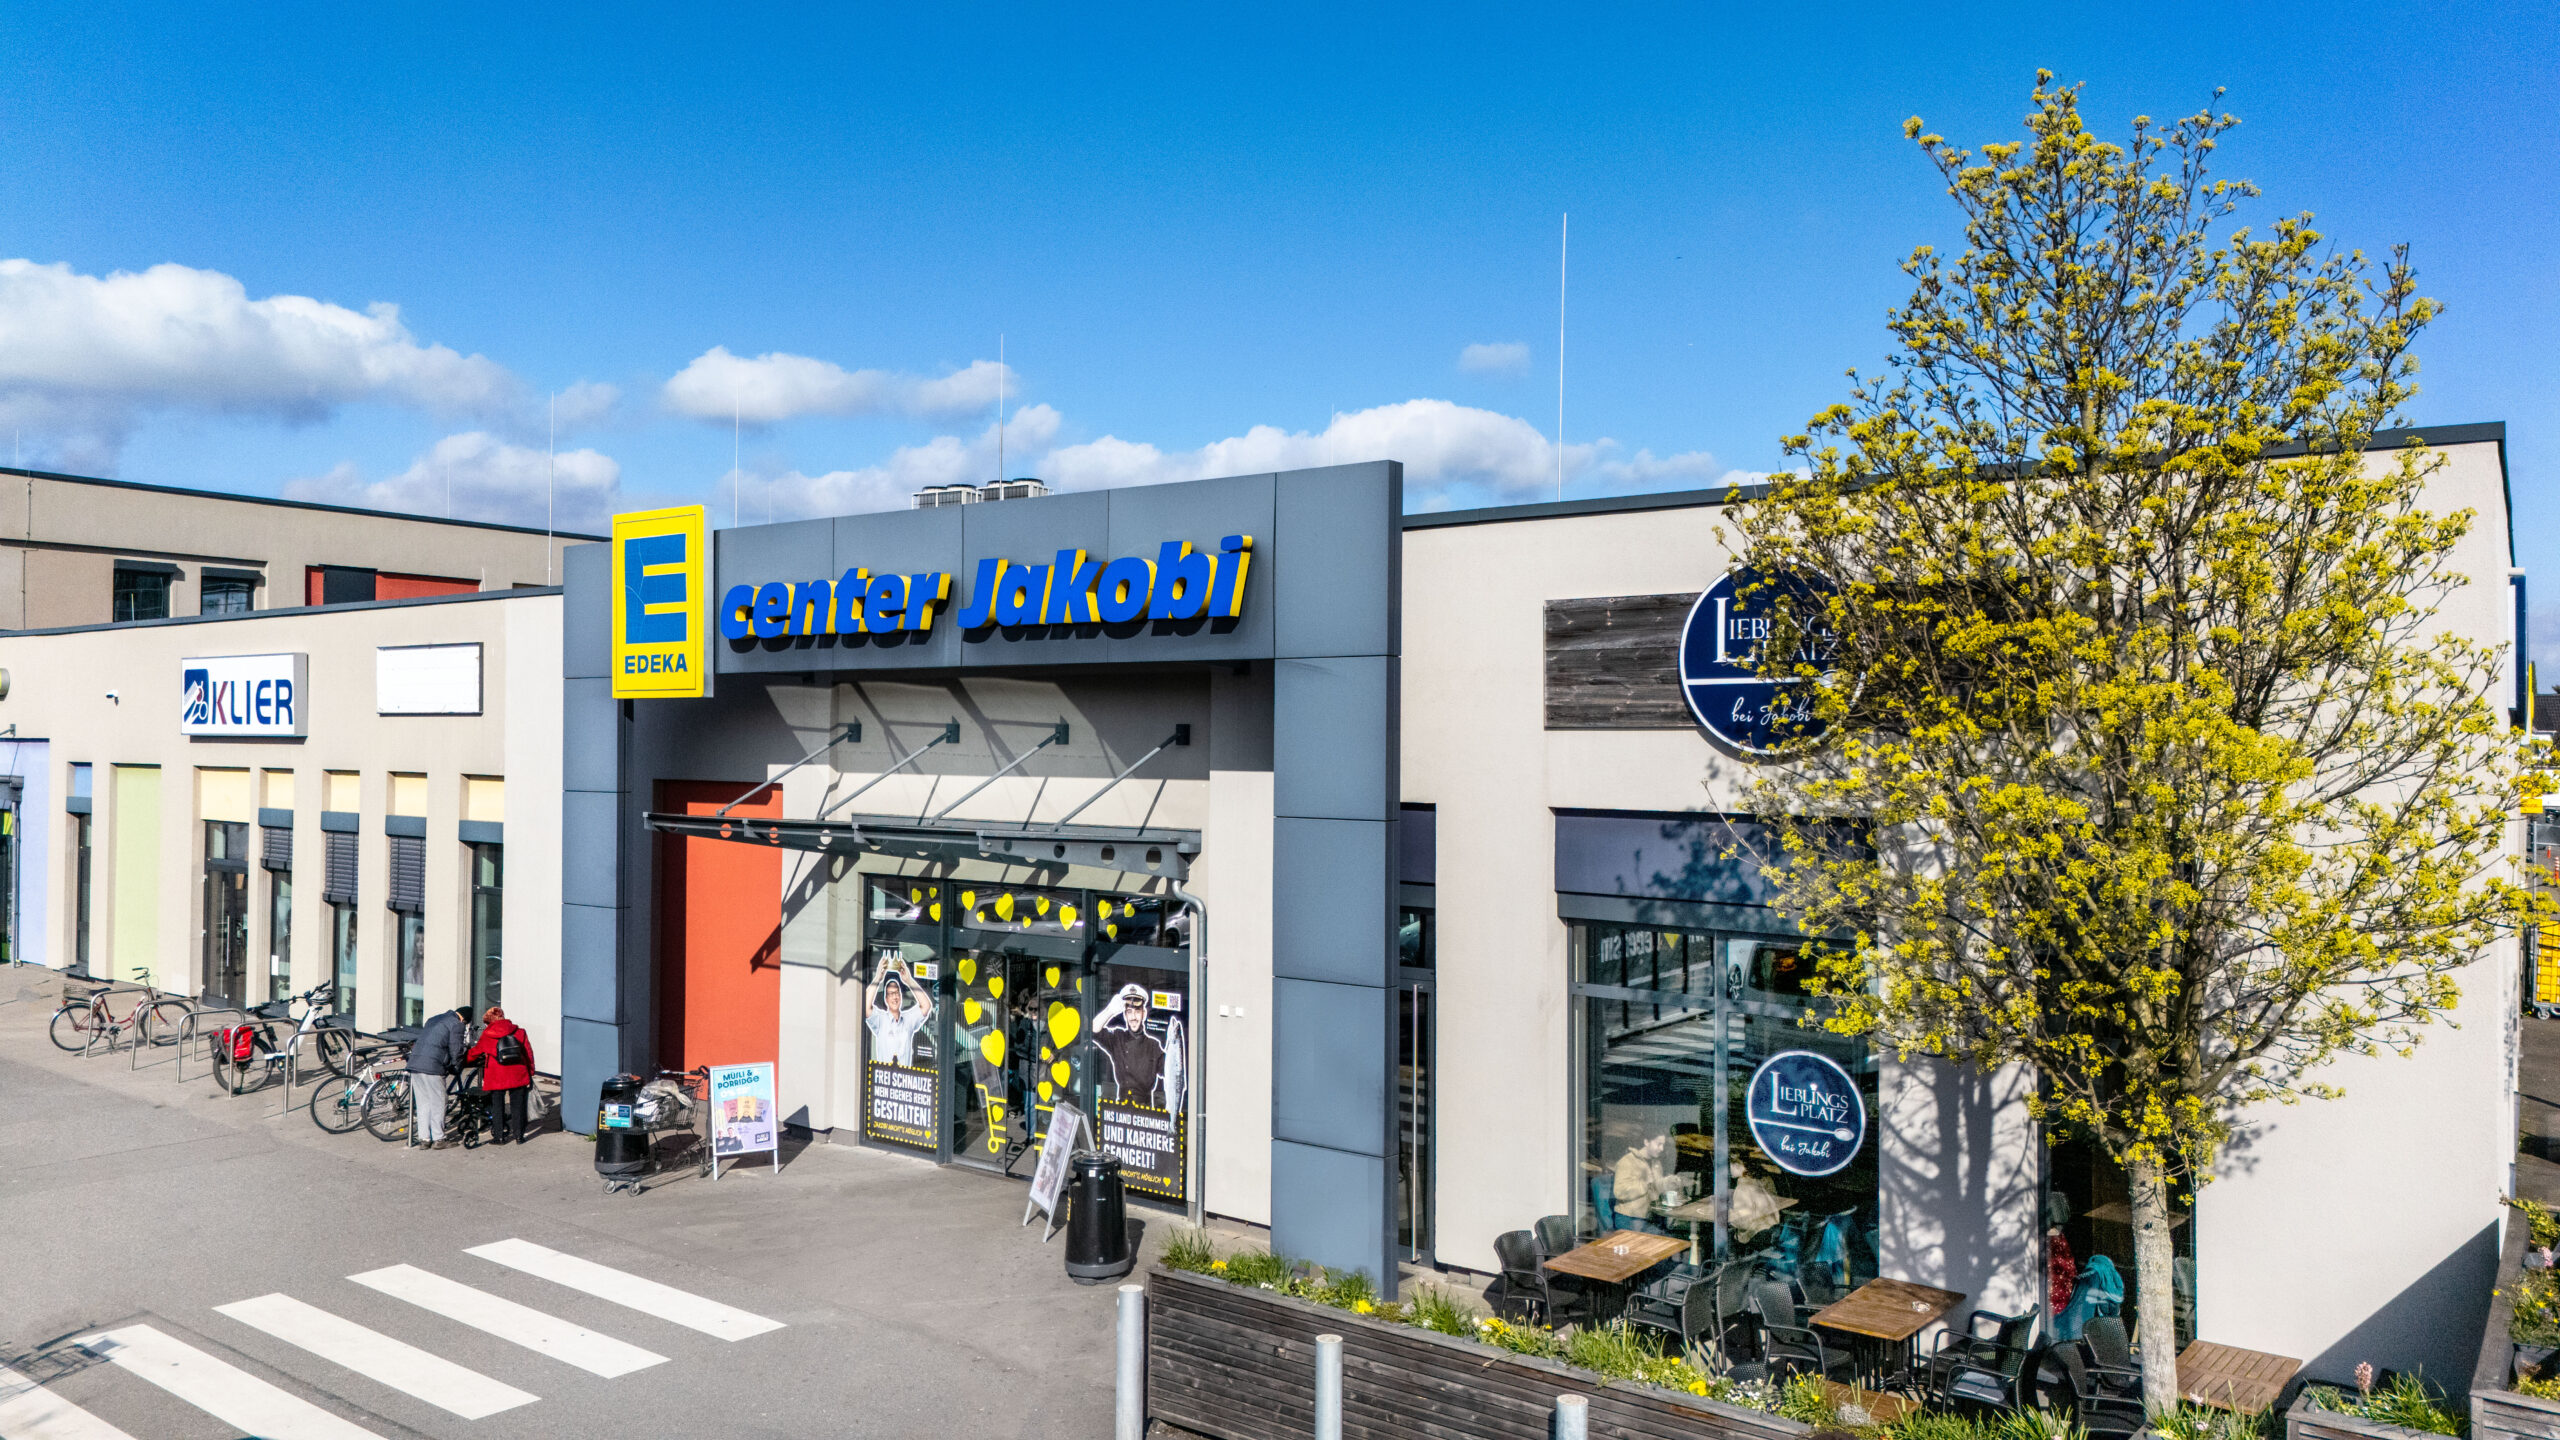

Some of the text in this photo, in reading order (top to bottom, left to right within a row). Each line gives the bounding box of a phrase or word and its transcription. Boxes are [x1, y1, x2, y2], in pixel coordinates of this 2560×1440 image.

[720, 535, 1253, 641] center Jakobi
[624, 653, 688, 674] EDEKA
[212, 679, 293, 725] KLIER
[1731, 696, 1753, 722] bei
[874, 1069, 932, 1093] FREI SCHNAUZE
[890, 1088, 913, 1103] EIGENES
[913, 1092, 932, 1107] REICH
[874, 1098, 932, 1128] GESTALTEN!
[1104, 1110, 1169, 1132] INS LAND GEKOMMEN
[1800, 1103, 1849, 1124] PLATZ
[1104, 1124, 1175, 1153] UND KARRIERE
[1781, 1134, 1831, 1158] bei Jakobi
